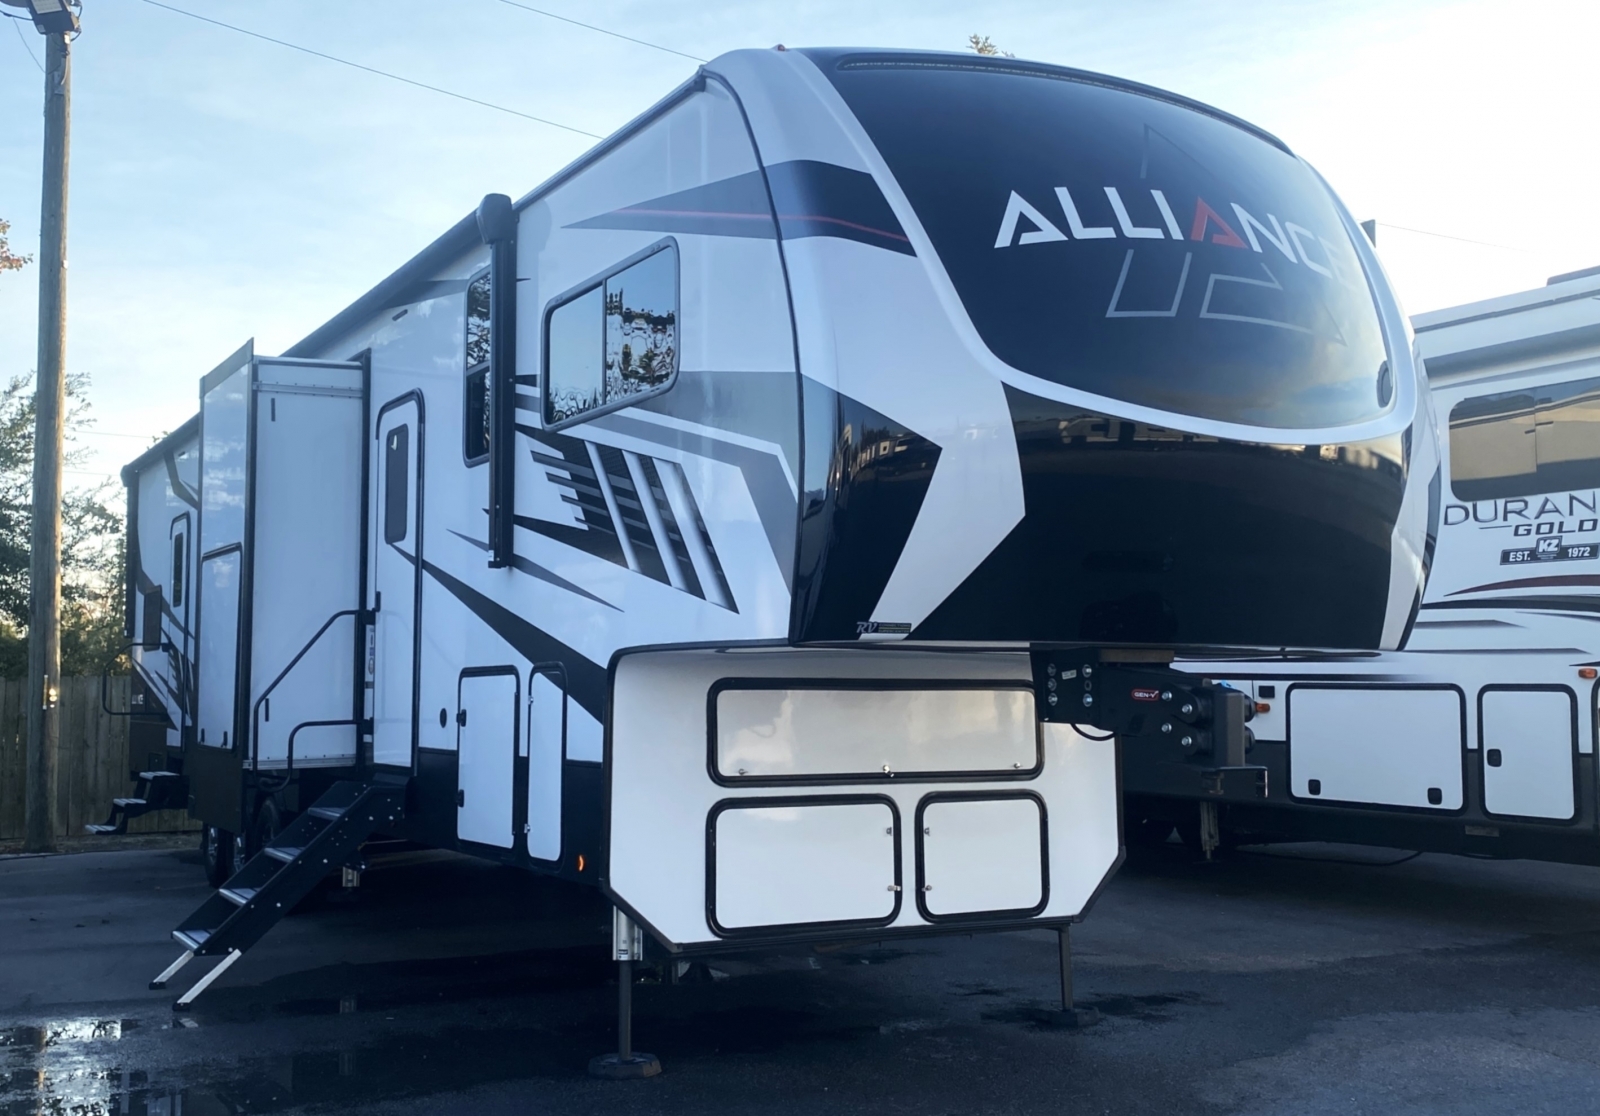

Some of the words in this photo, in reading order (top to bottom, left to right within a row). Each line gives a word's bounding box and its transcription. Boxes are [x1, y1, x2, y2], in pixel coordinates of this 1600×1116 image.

[994, 186, 1353, 286] ALLIANCE
[1444, 491, 1597, 525] DURAN
[1513, 518, 1598, 537] GOLD
[1509, 551, 1530, 562] EST.
[1567, 546, 1590, 558] 1972
[1538, 538, 1559, 553] KZ
